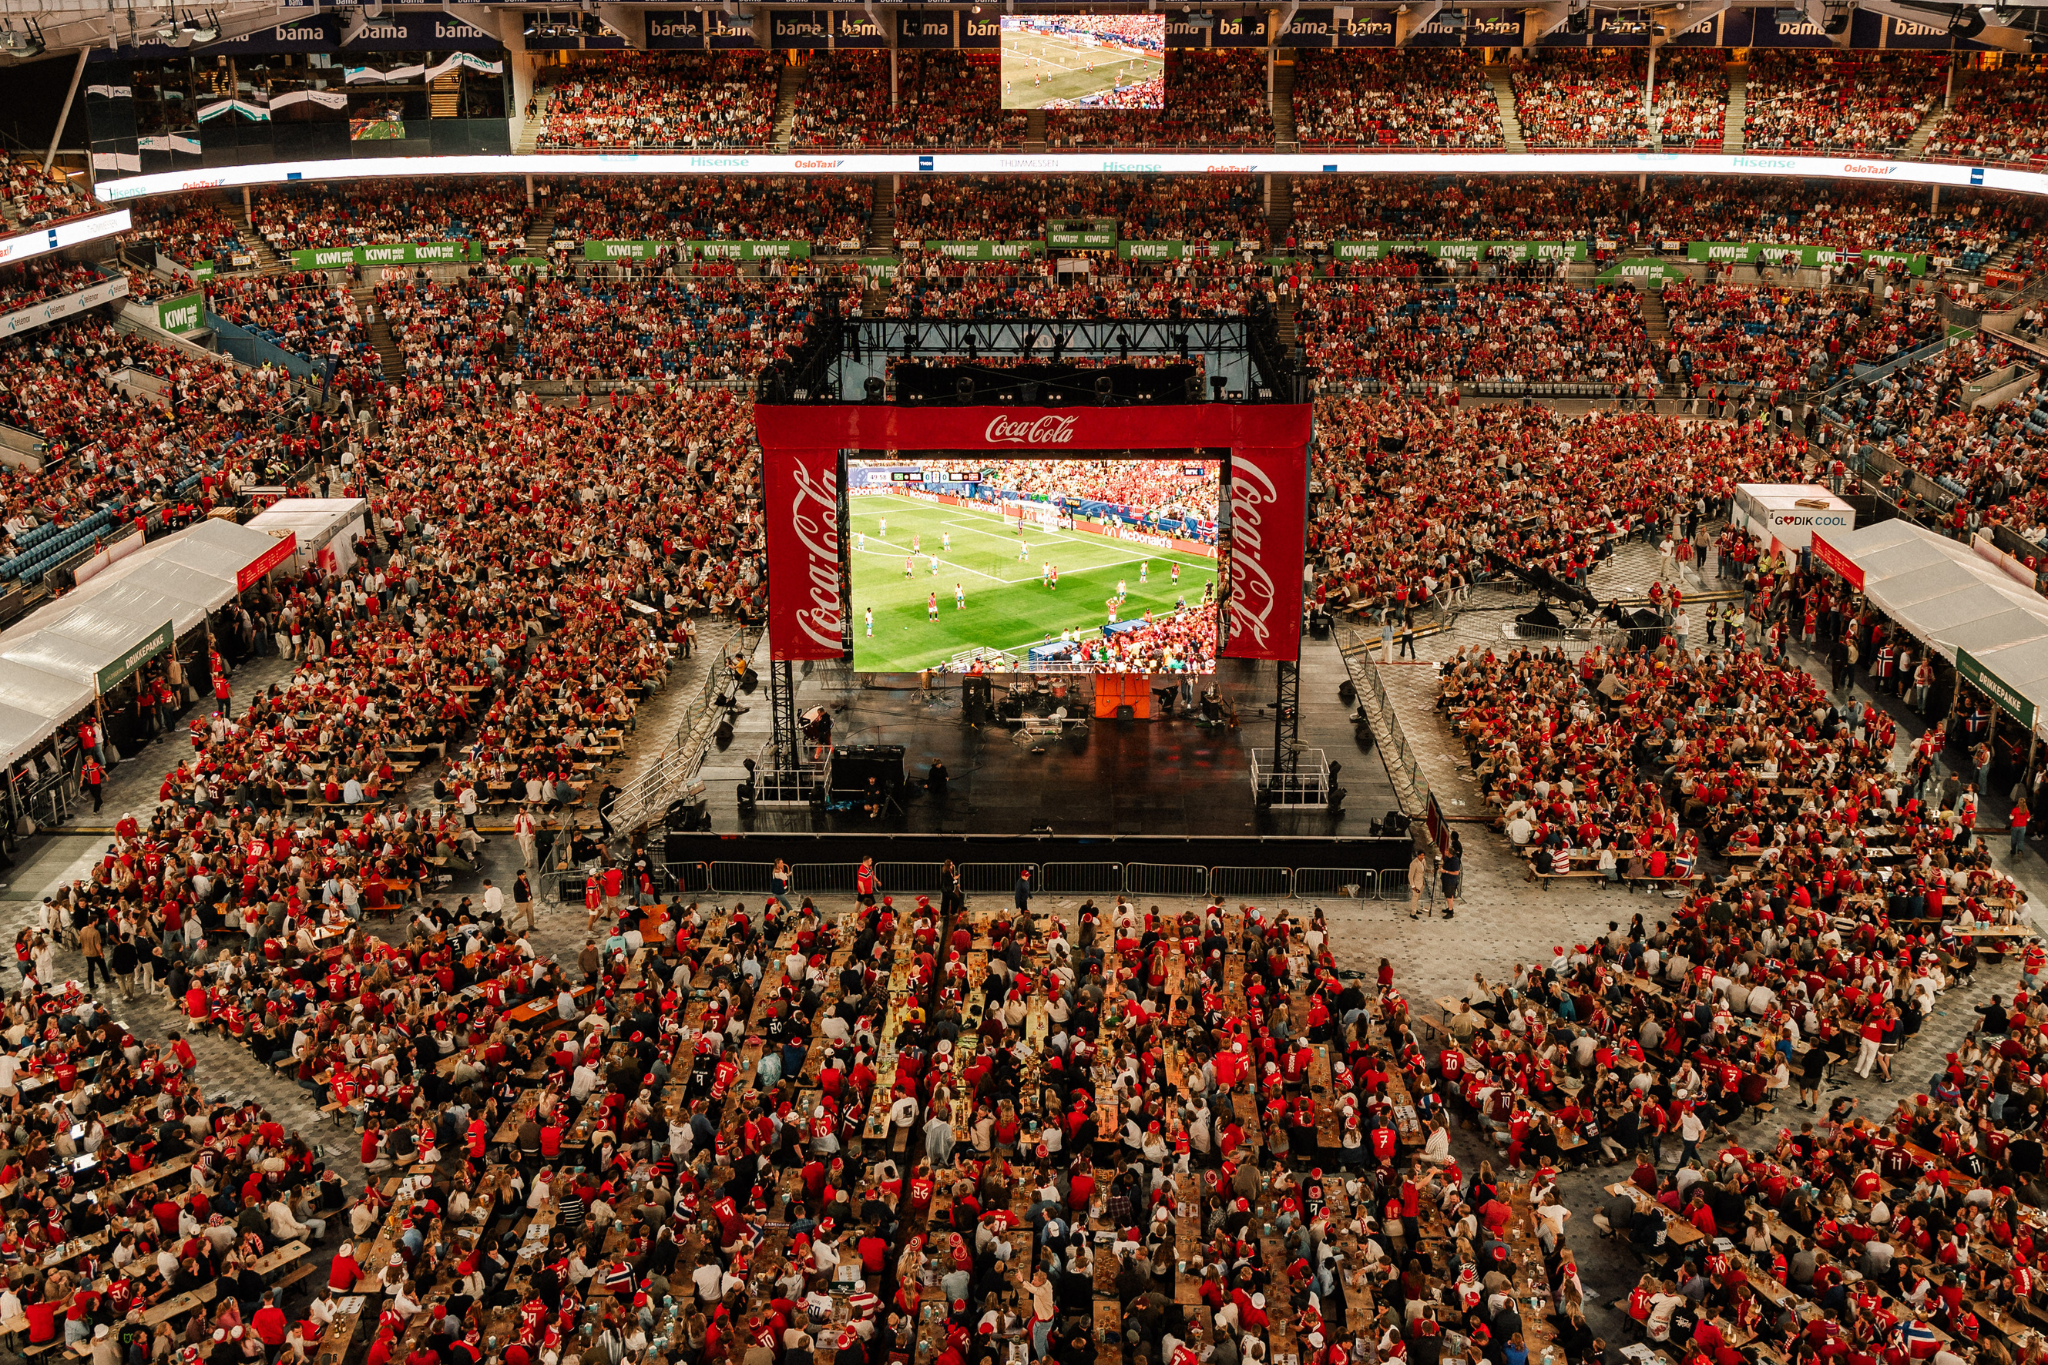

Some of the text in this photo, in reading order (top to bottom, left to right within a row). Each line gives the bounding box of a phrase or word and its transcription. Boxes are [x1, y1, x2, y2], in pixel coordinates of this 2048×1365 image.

[276, 26, 324, 41] bama
[436, 22, 483, 38] bama
[777, 20, 821, 36] bama
[691, 157, 749, 167] Hisense
[795, 160, 837, 169] OsloTaxi
[1104, 162, 1162, 172] Hisense
[1733, 157, 1797, 169] Hisense
[1844, 164, 1889, 175] OsloTaxi
[1053, 235, 1069, 243] KIWI
[1085, 235, 1101, 243] KIWI
[365, 249, 391, 261] KIWI
[415, 247, 441, 259] KIWI
[606, 245, 631, 256] KIWI
[752, 245, 778, 256] KIWI
[941, 245, 966, 256] KIWI
[992, 245, 1017, 256] KIWI
[1130, 245, 1155, 256] KIWI
[1341, 245, 1366, 256] KIWI
[1440, 245, 1465, 256] KIWI
[1538, 246, 1563, 256] KIWI
[1709, 246, 1735, 257] KIWI
[316, 251, 341, 264] KIWI
[1817, 251, 1836, 262] KIW
[1621, 266, 1650, 276] KIWI
[165, 307, 187, 329] KIWI
[985, 414, 1079, 444] Coca-Cola
[850, 486, 893, 496] cDonald's
[1815, 516, 1847, 525] COOL
[1120, 528, 1172, 549] McDonald's
[793, 456, 843, 650] Coca-Cola
[1231, 455, 1277, 650] Coca-Cola
[125, 633, 165, 670] DRIKKEPAKKE
[1979, 672, 2021, 712] DRIKKEPAKKE
[251, 846, 262, 856] 20
[147, 861, 157, 870] 14
[330, 983, 336, 993] 8
[770, 1023, 782, 1034] 20
[1446, 1059, 1457, 1070] 10
[1526, 1065, 1532, 1074] 6
[696, 1075, 703, 1086] 9
[720, 1071, 726, 1083] 9
[1728, 1073, 1736, 1083] 7
[816, 1127, 827, 1137] 10
[1380, 1135, 1388, 1149] 7
[1892, 1157, 1901, 1170] 11
[1971, 1159, 1981, 1173] 11
[913, 1186, 929, 1200] 26
[721, 1204, 733, 1216] 9
[1311, 1203, 1318, 1217] 9
[1715, 1263, 1726, 1275] 10
[112, 1289, 130, 1303] 20
[1868, 1300, 1876, 1310] 7
[807, 1304, 821, 1318] 60
[528, 1313, 537, 1328] 9
[1875, 1317, 1886, 1330] 10
[762, 1336, 775, 1349] 10
